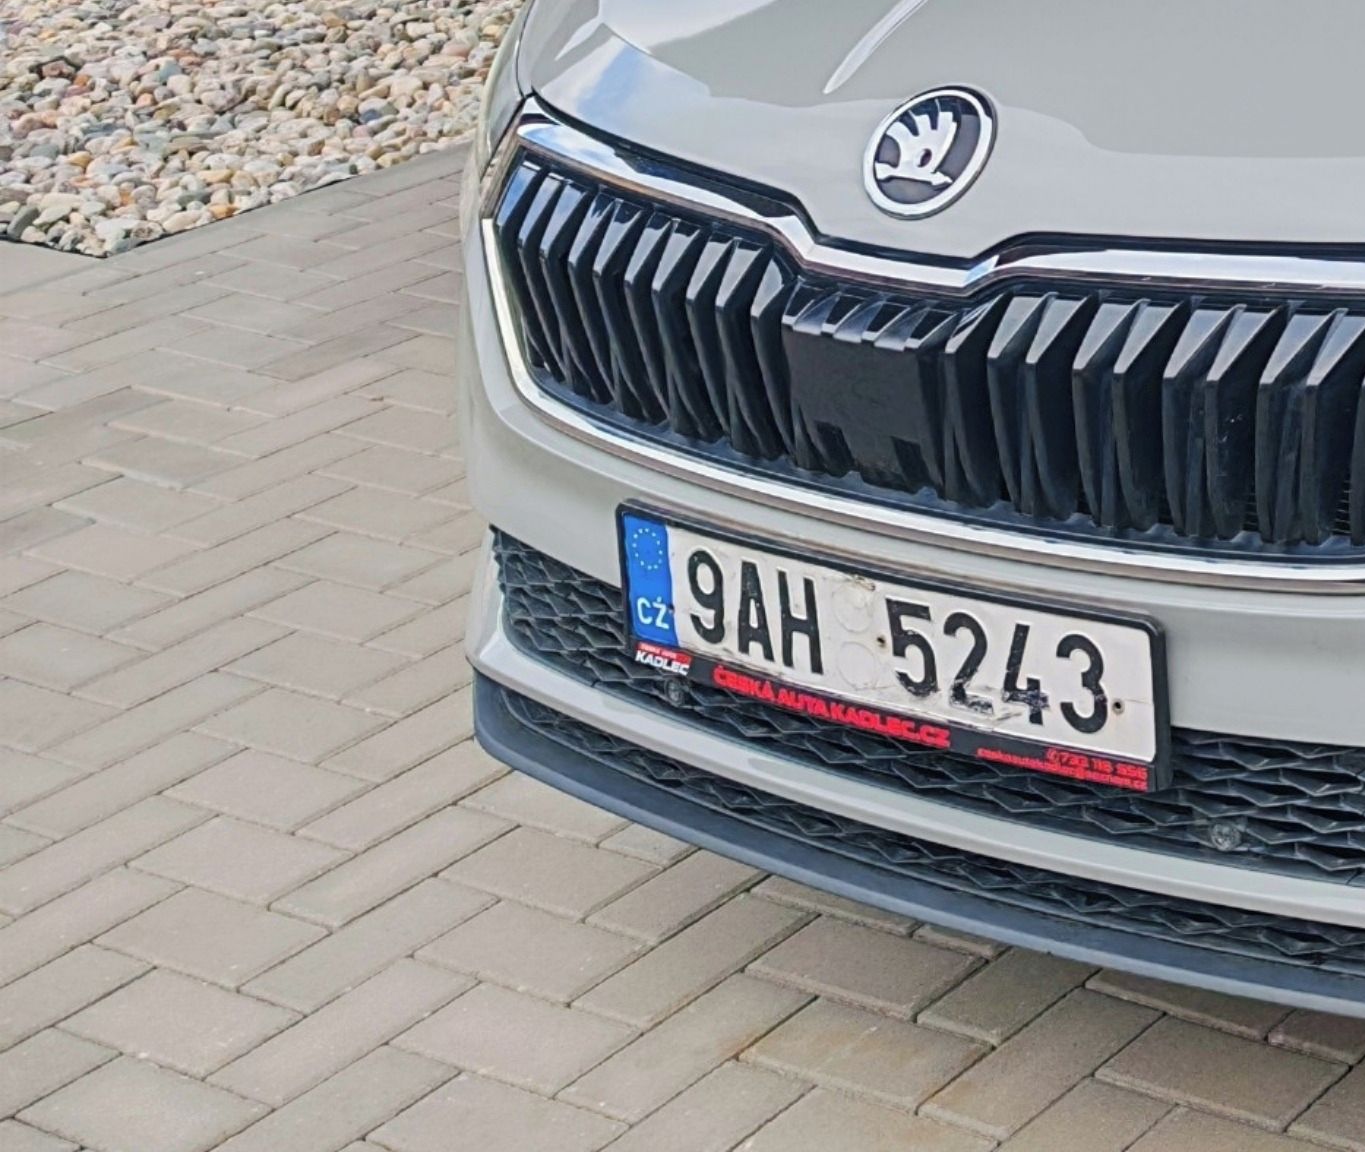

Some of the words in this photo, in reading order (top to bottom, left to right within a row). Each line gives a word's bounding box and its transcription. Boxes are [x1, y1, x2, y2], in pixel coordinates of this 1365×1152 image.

[637, 598, 669, 629] CZ
[688, 550, 823, 675] 9AH
[886, 597, 1107, 733] 5243
[635, 650, 690, 676] KADLEC
